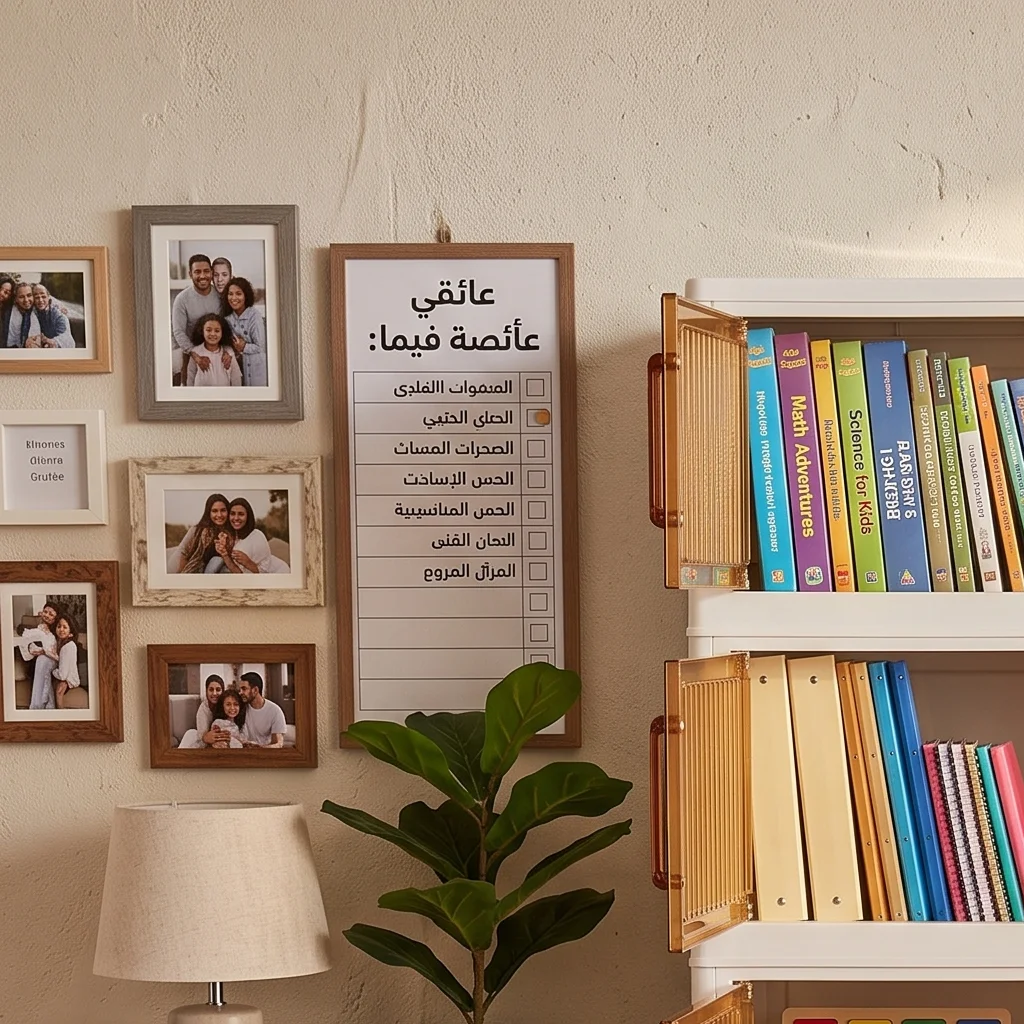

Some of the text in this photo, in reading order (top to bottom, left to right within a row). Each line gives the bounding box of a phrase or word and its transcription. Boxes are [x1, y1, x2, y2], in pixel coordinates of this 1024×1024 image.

[790, 395, 814, 538] Math Adventures
[855, 475, 869, 498] for
[858, 501, 874, 535] Kids
